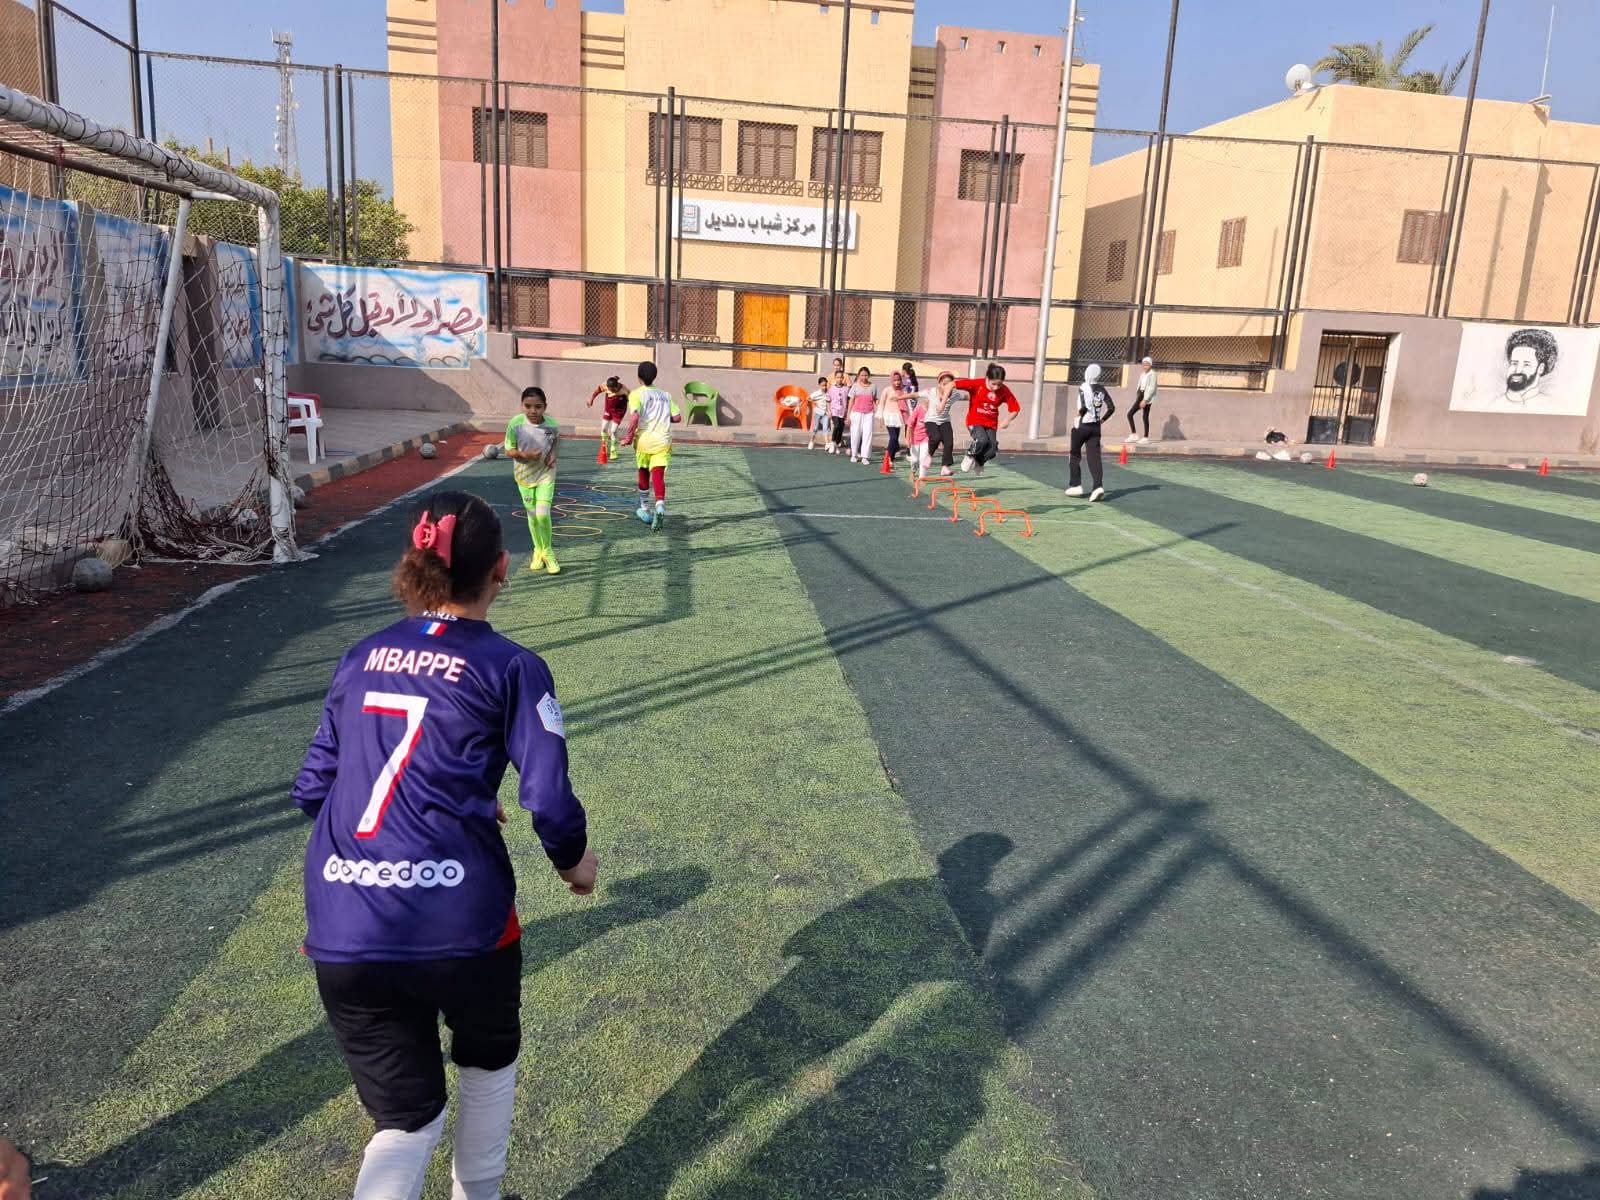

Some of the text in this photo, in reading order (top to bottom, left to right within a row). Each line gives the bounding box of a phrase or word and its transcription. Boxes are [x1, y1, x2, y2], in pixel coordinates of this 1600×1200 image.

[704, 212, 816, 236] مركز شباب دنديل
[326, 283, 355, 338] كل
[348, 292, 395, 338] وقبل
[424, 307, 484, 336] مصر
[363, 647, 466, 683] MBAPPE
[354, 691, 429, 839] 7
[325, 855, 463, 886] ooredoo
